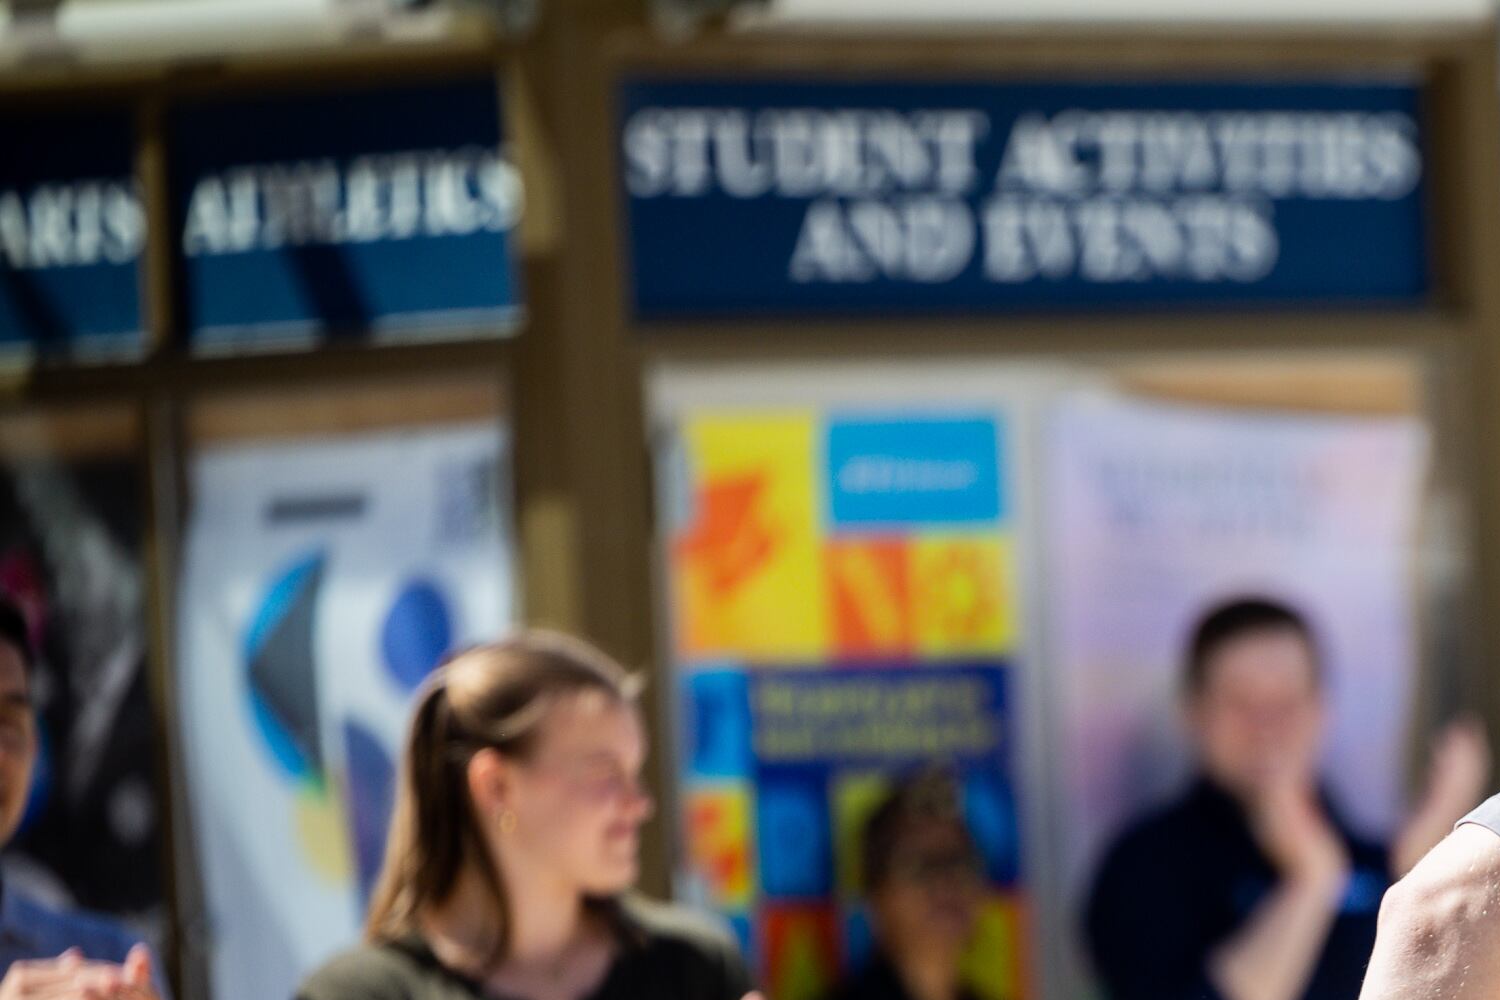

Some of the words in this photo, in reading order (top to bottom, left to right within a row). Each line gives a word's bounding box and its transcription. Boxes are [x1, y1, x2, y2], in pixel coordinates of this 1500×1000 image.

[625, 108, 988, 197] STUDENT
[1000, 110, 1420, 198] ACTIVITIES
[184, 146, 523, 256] ATHLETICS
[791, 195, 975, 282] AND
[983, 196, 1279, 282] EVENTS
